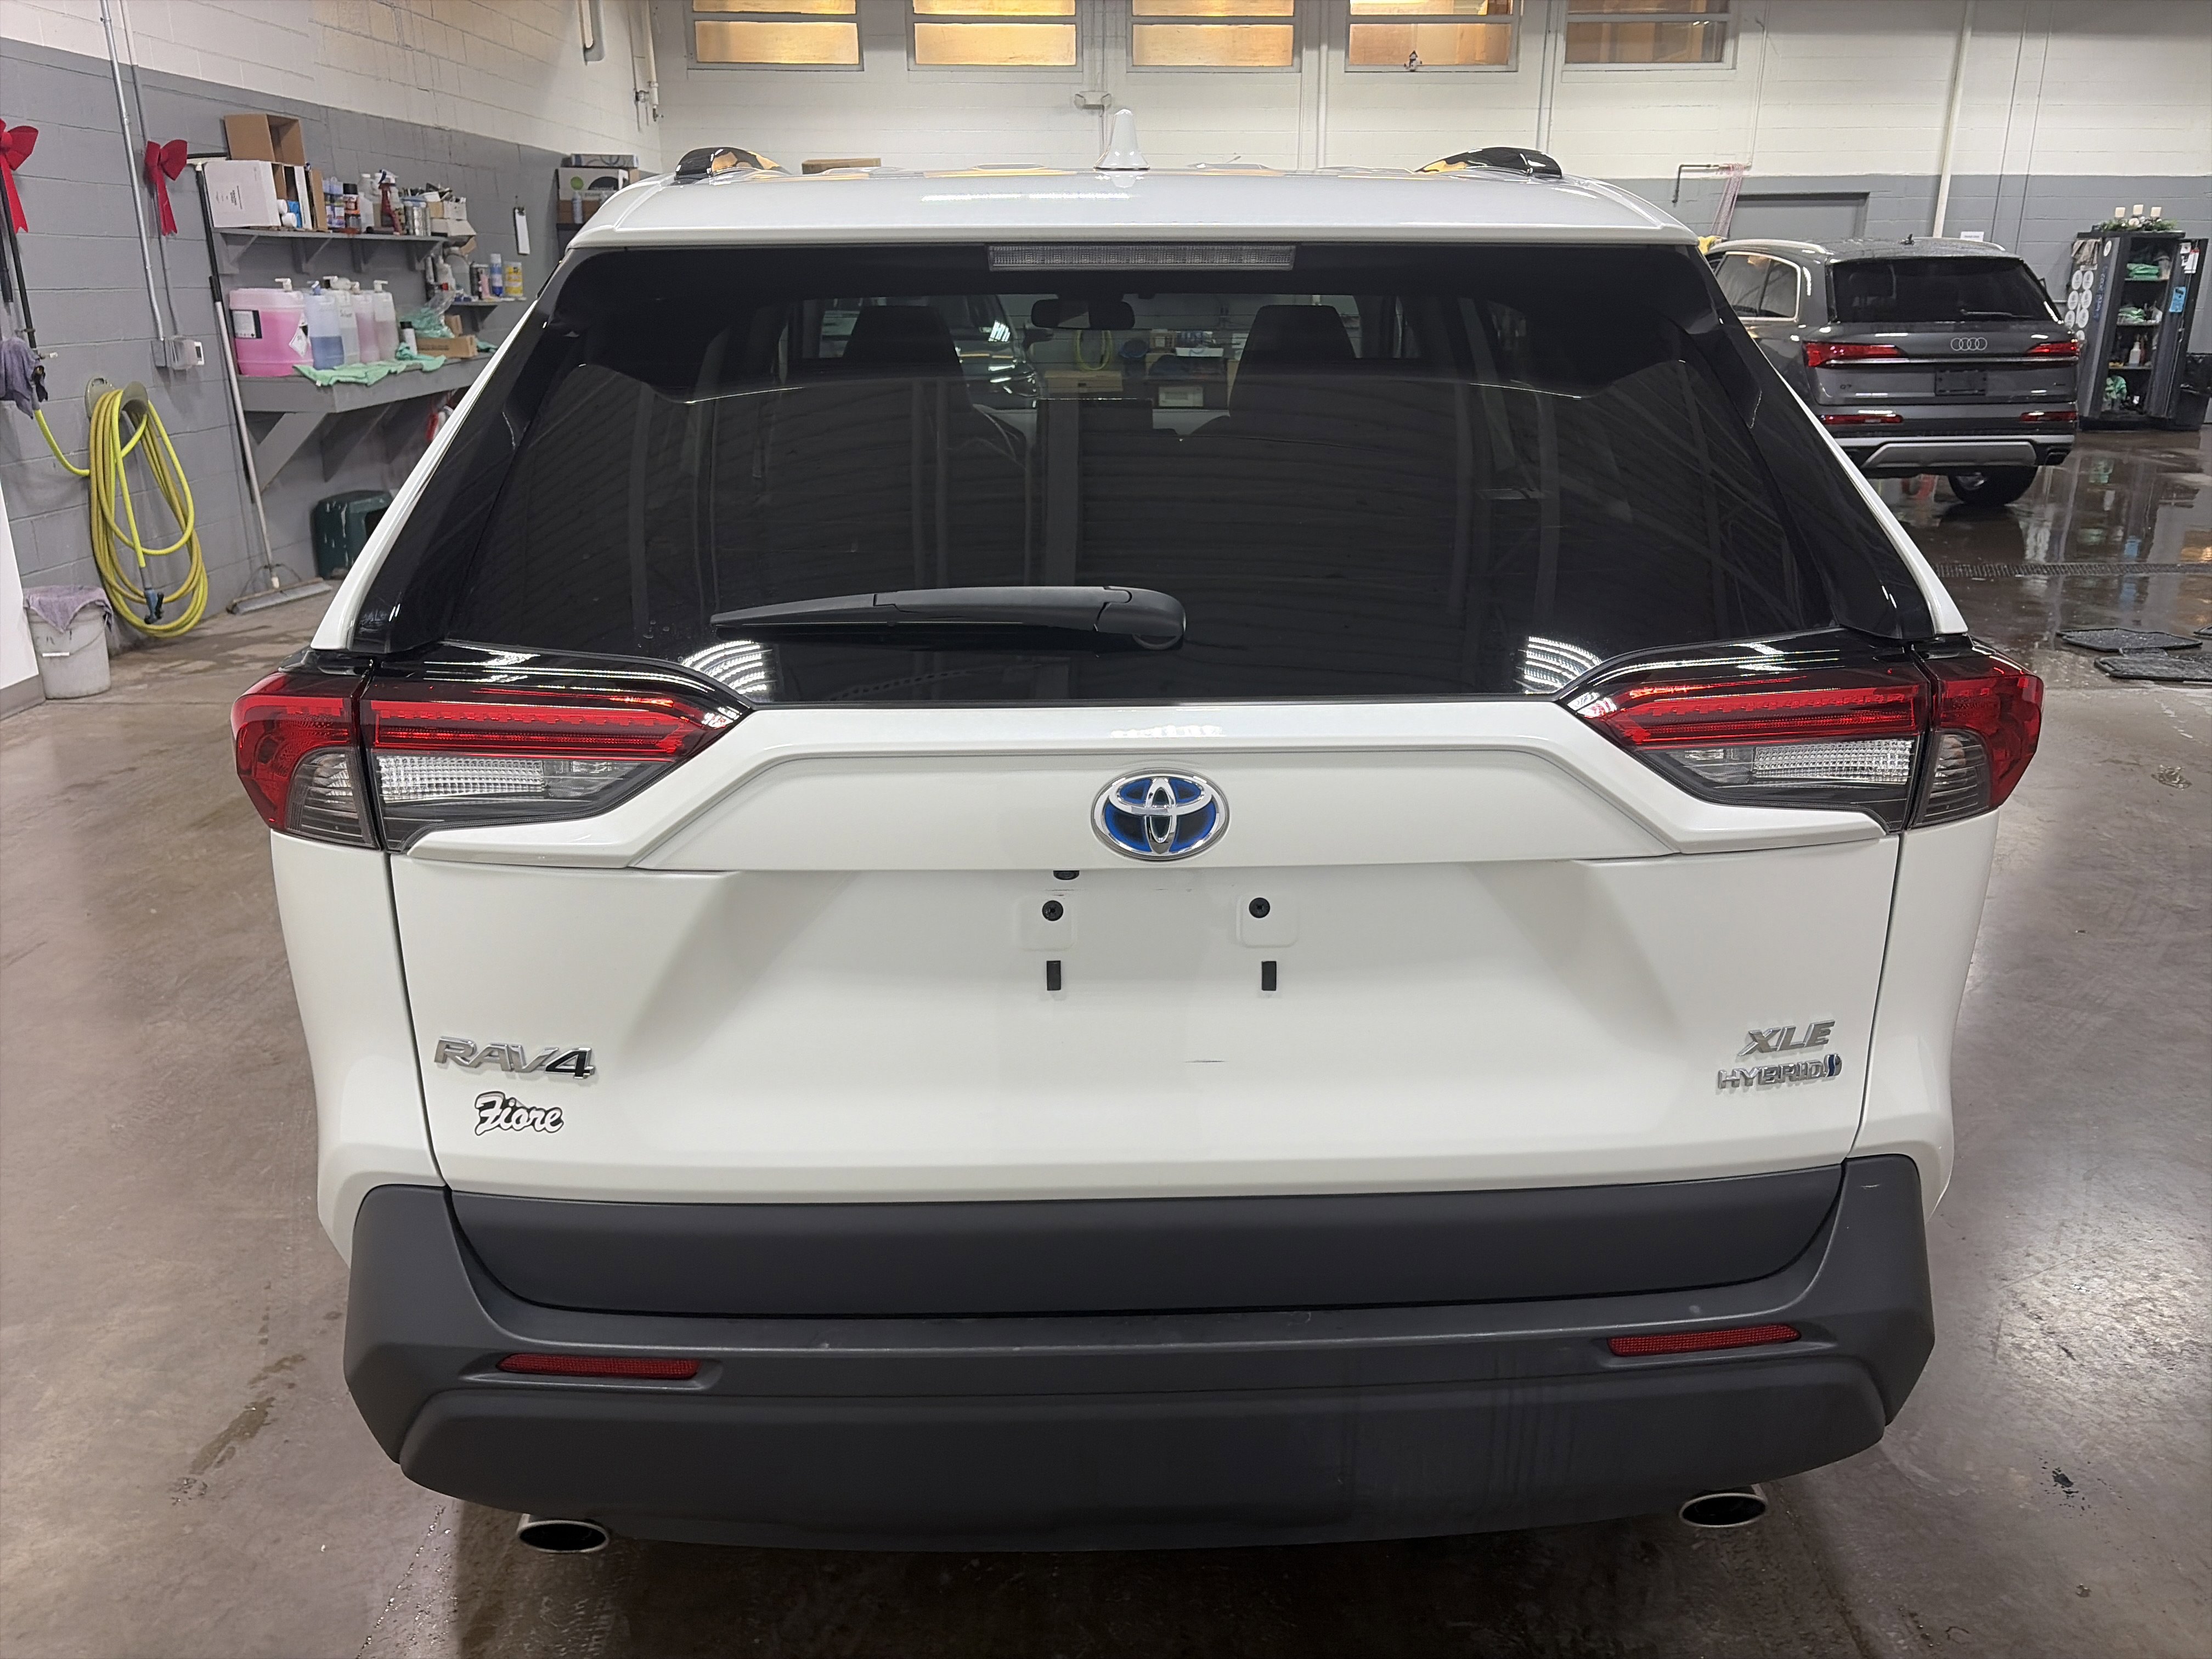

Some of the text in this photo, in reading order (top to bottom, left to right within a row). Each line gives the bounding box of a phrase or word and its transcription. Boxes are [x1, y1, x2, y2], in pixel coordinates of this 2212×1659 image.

[434, 1036, 595, 1079] RAV4
[1737, 1019, 1835, 1056] XLE
[1718, 1059, 1824, 1088] HYBRID
[475, 1091, 564, 1136] Fiore
